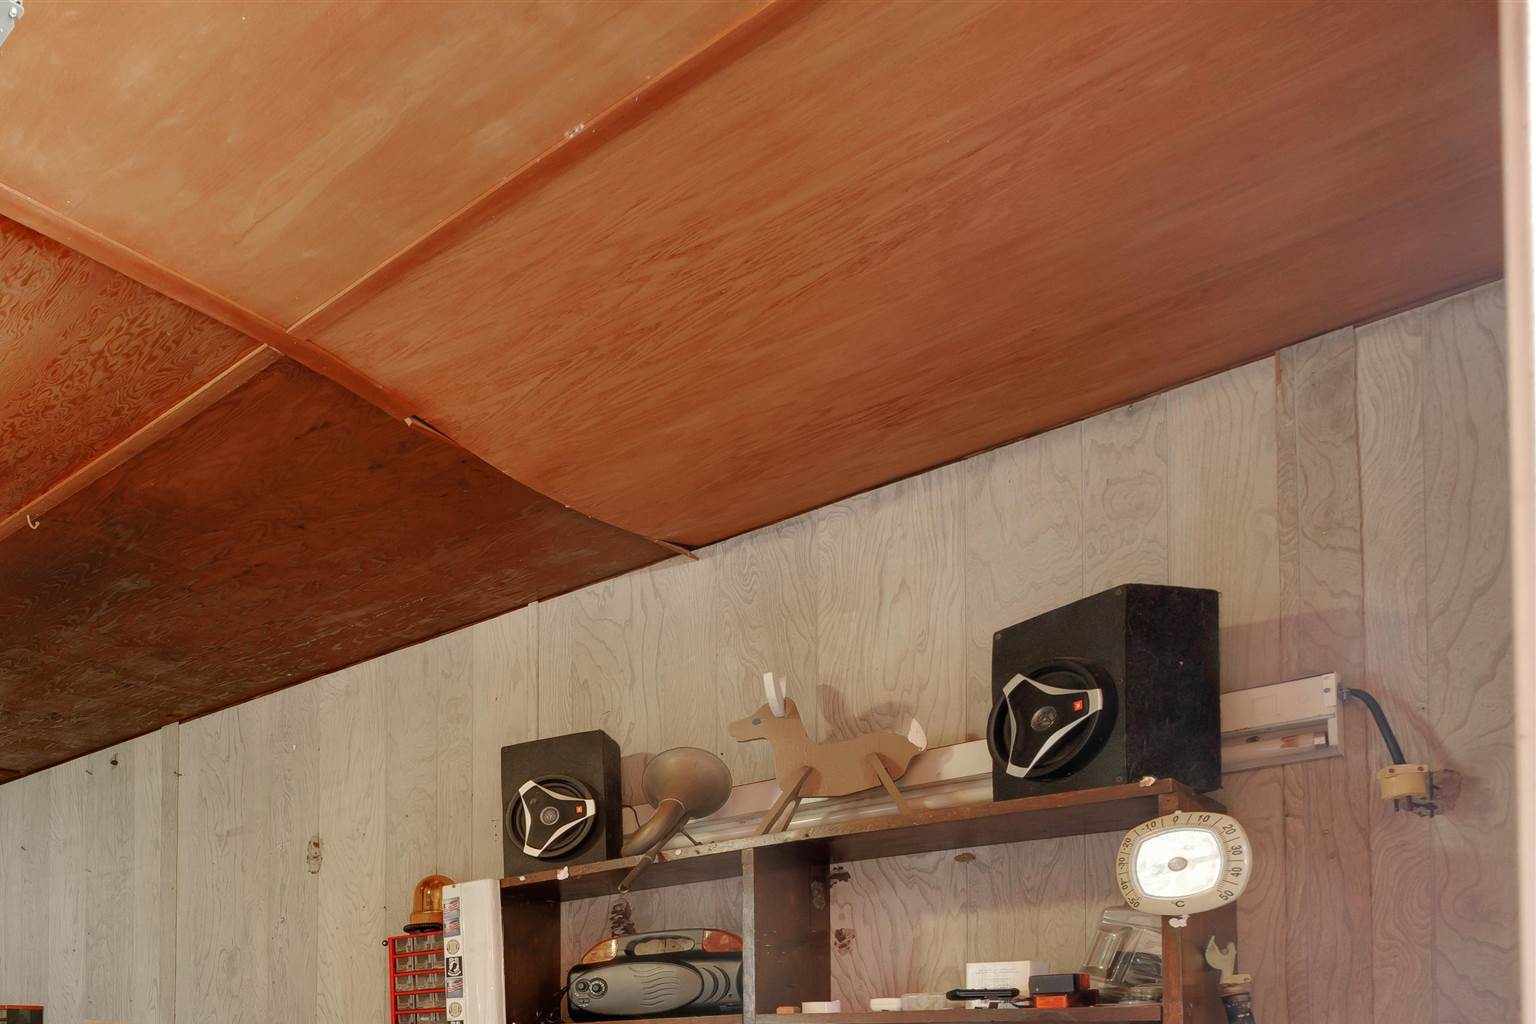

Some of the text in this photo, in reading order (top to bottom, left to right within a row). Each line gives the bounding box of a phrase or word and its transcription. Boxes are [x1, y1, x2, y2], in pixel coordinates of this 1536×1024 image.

[1172, 815, 1179, 824] 0
[1197, 814, 1211, 823] 10
[1222, 824, 1237, 835] 20
[1231, 844, 1243, 856] 30
[1231, 866, 1243, 878] 40
[1218, 889, 1234, 901] 50
